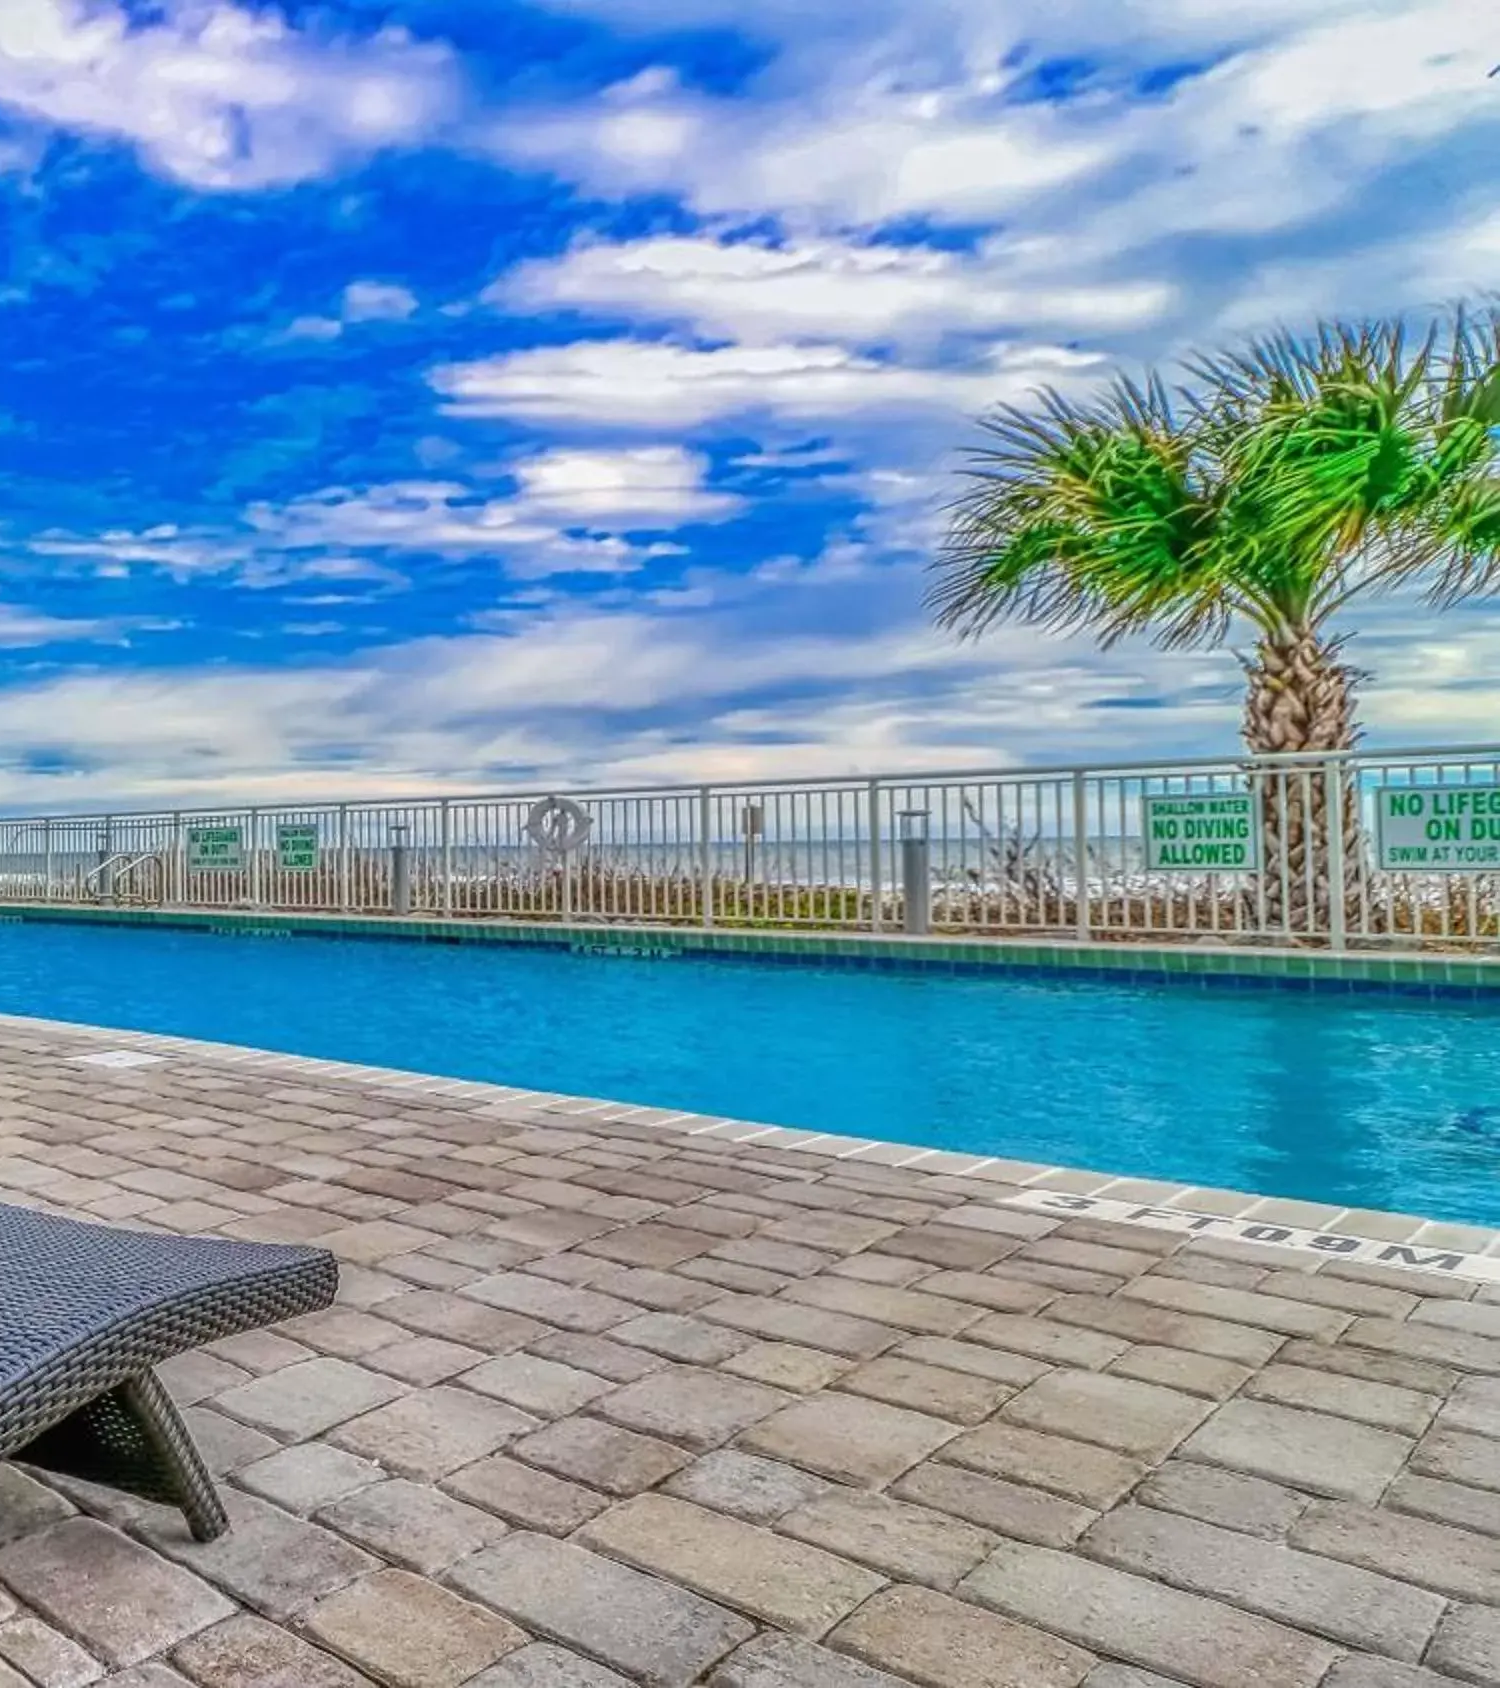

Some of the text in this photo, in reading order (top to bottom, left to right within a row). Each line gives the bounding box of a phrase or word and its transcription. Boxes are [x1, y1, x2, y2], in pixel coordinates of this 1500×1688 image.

[1209, 800, 1249, 814] WATER
[1390, 793, 1423, 816] NO
[1153, 818, 1249, 839] NO DIVING
[1426, 819, 1460, 840] ON
[1159, 843, 1245, 864] ALLOWED
[1388, 846, 1498, 862] SWIM AT YOUR
[1041, 1195, 1098, 1210] 3
[1125, 1207, 1234, 1230] FT
